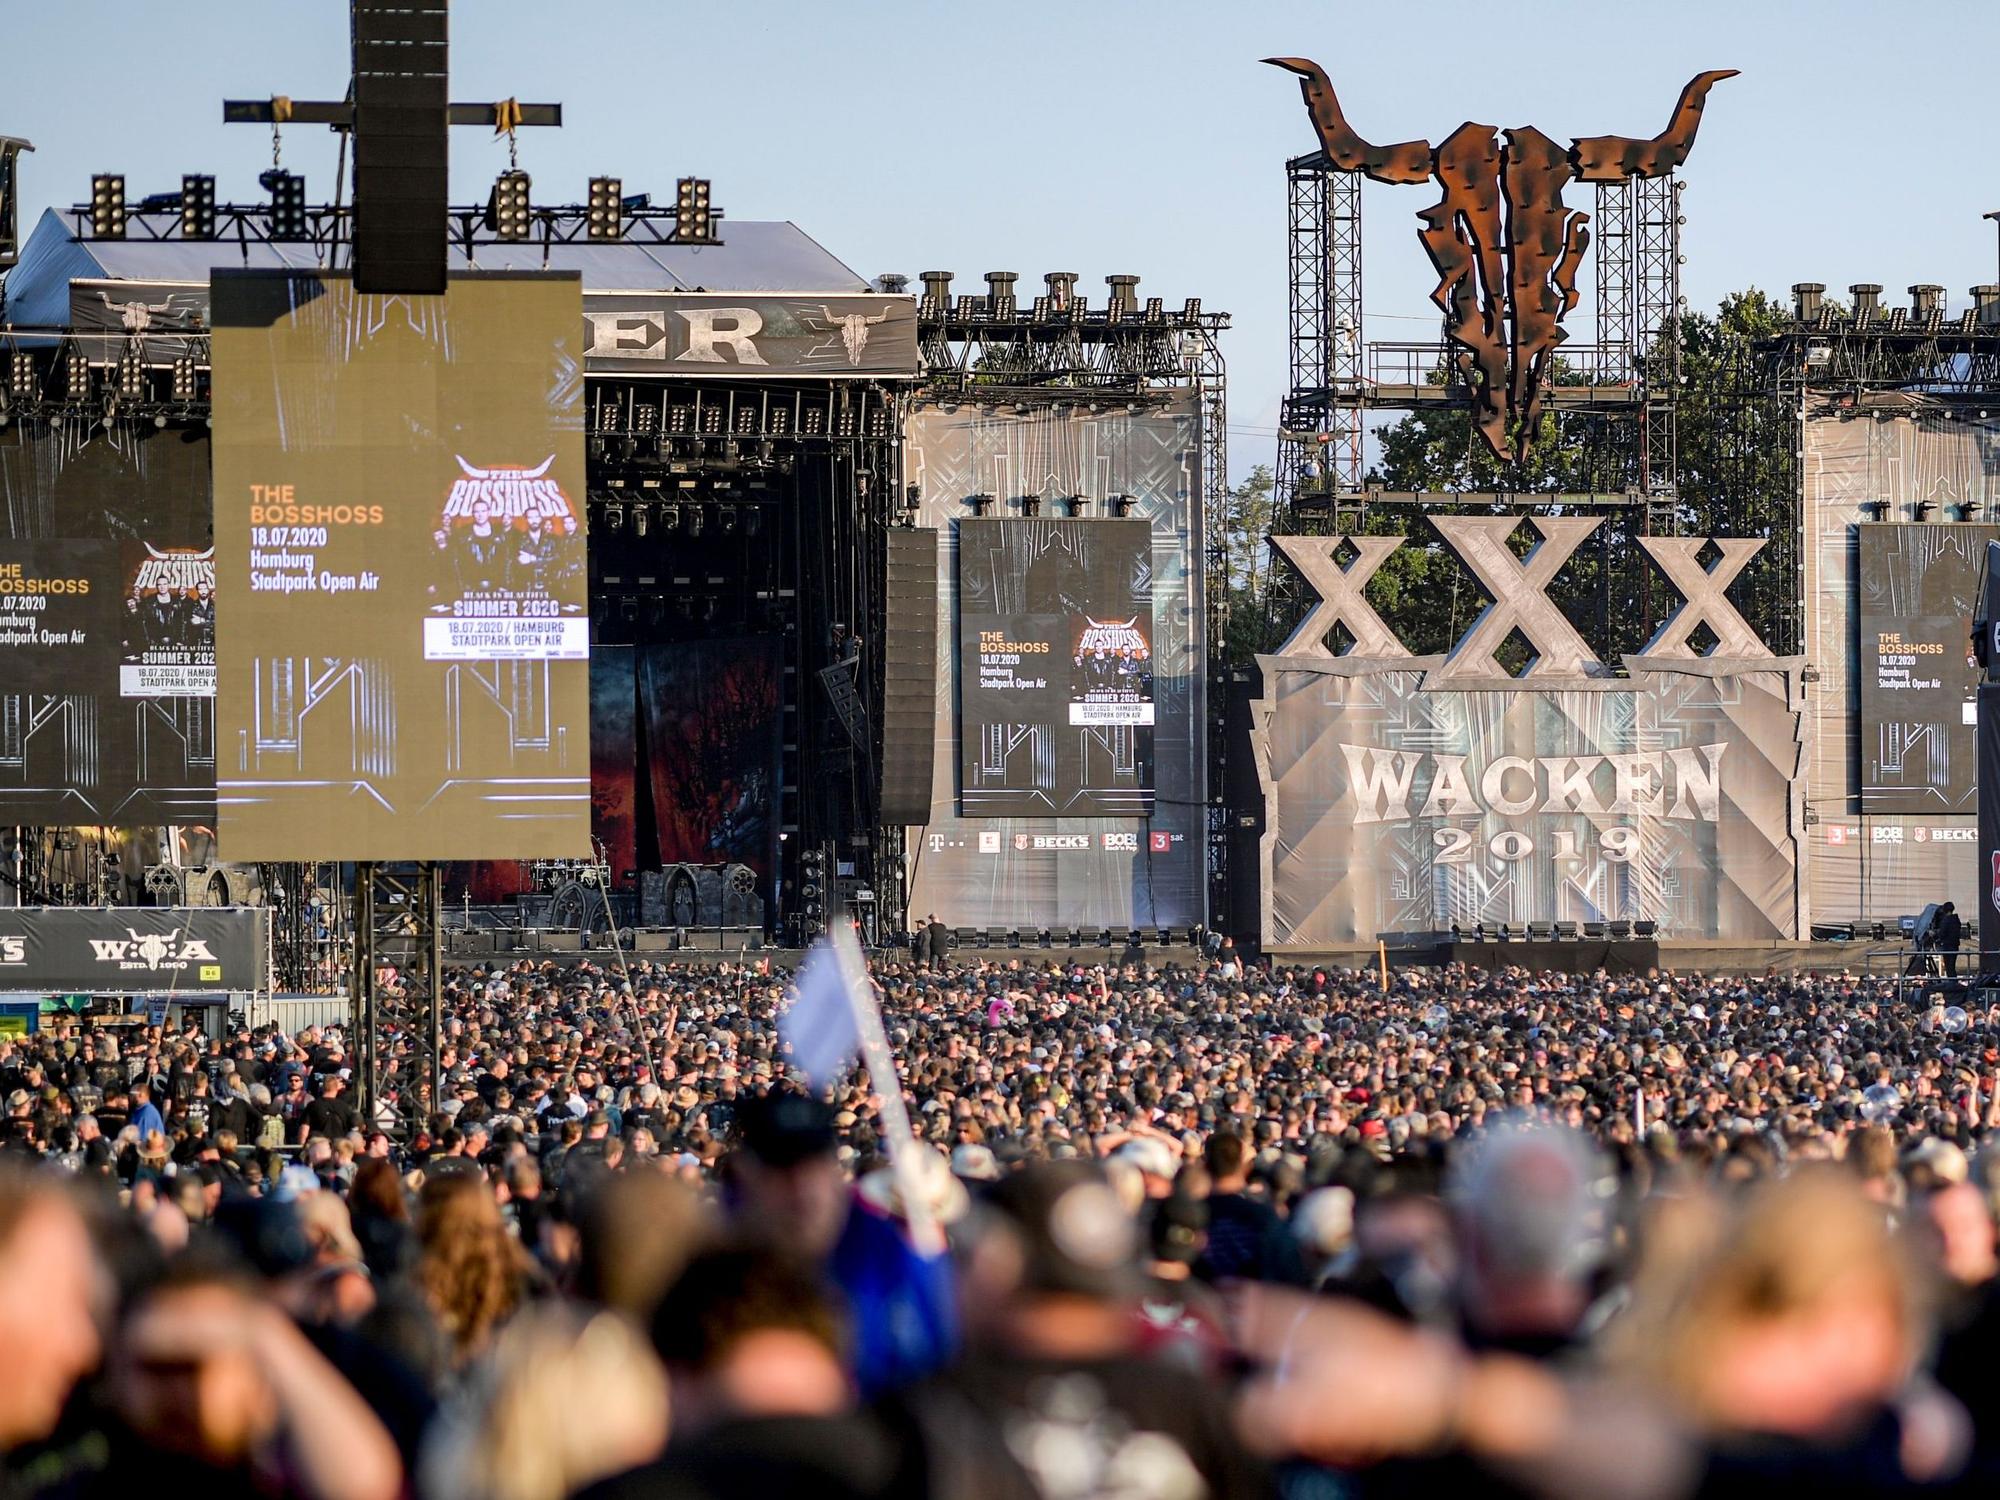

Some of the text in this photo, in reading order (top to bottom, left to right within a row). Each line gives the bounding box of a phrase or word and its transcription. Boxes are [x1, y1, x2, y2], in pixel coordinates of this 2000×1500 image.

[250, 485, 295, 504] THE
[442, 479, 570, 517] BOSSHOSS
[251, 505, 384, 524] BOSSHOSS
[251, 527, 328, 547] 18.07.2020
[250, 548, 314, 572] Hamburg
[134, 560, 215, 588] BOSSHOS
[251, 571, 380, 594] Stadtpark Open Air
[453, 600, 560, 617] SUMMER 2020
[448, 622, 503, 633] 18.07.2020
[513, 622, 565, 633] HAMBURG
[41, 629, 68, 648] Open
[70, 629, 86, 643] Air
[451, 635, 562, 646] STADTPARK OPEN AIR
[980, 631, 1004, 642] THE
[1878, 633, 1901, 643] THE
[980, 642, 1049, 653] BOSSHOSS
[1878, 643, 1943, 654] BOSSHOSS
[142, 652, 215, 664] SUMMER 202
[980, 654, 1020, 665] 18.07.2020
[1879, 655, 1916, 665] 18.07.2020
[138, 668, 180, 677] 18.07.2020
[980, 665, 1013, 678] Hamburg
[1878, 666, 1910, 679] Hamburg
[140, 678, 185, 687] STADTPARK
[187, 678, 209, 687] OPEN
[980, 677, 1047, 690] Stadtpark Open Air
[1878, 678, 1941, 690] Stadtpark Open Air
[1084, 693, 1139, 702] SUMMER 2020
[1338, 742, 1729, 824] WACKEN
[1034, 835, 1089, 848] BECK'S
[1433, 827, 1640, 864] 2019
